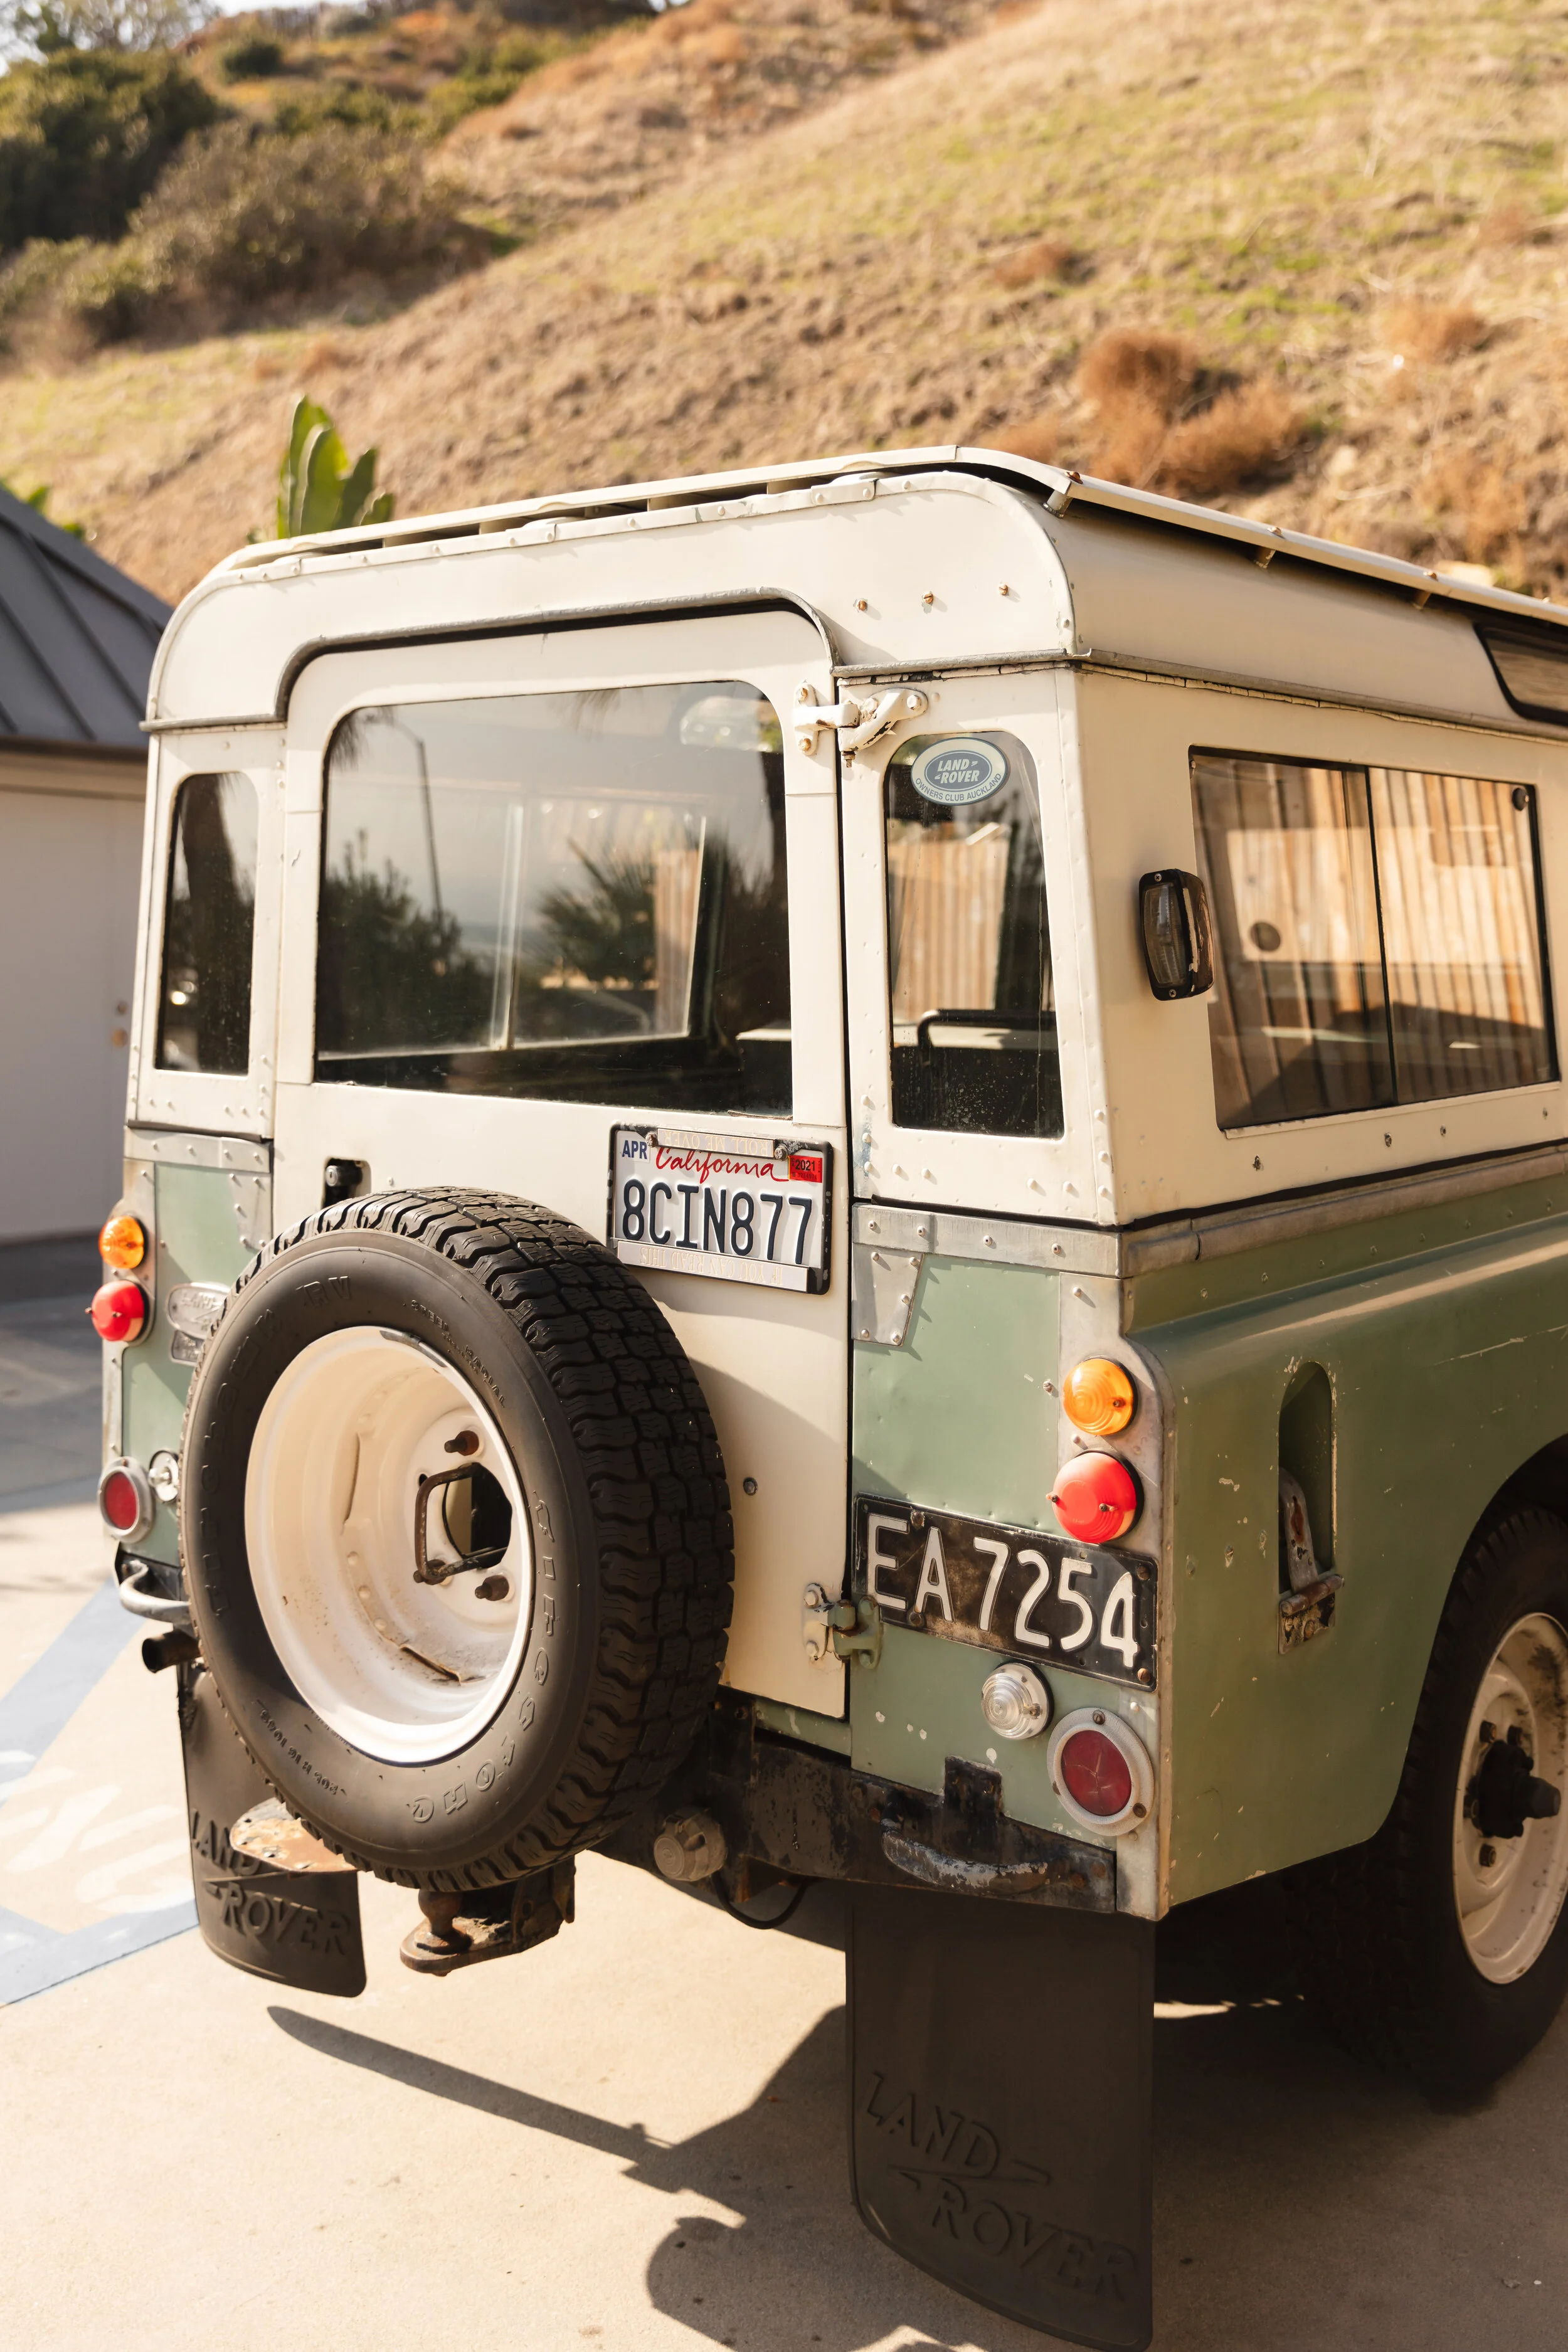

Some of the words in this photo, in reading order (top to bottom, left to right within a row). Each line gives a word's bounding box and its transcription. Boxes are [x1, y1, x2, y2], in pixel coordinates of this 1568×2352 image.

[937, 759, 970, 771] LAND
[940, 770, 980, 784] ROVER
[916, 778, 943, 800] OWNERS
[945, 793, 965, 802] CLUB
[967, 773, 1002, 800] AUCKLAND
[663, 1131, 700, 1144] OVER
[705, 1134, 725, 1148] ME
[728, 1136, 768, 1154] ROLL
[622, 1140, 647, 1160] APR
[655, 1147, 789, 1184] California
[795, 1158, 815, 1172] 2021
[622, 1179, 813, 1264] 8CIN877
[640, 1247, 666, 1267] THIS
[670, 1251, 704, 1274] READ
[709, 1258, 735, 1278] CAN
[739, 1262, 766, 1283] YOU
[770, 1264, 784, 1280] IF
[867, 1513, 955, 1623] EA
[973, 1536, 1139, 1668] 7254
[221, 1882, 351, 1956] ROVER
[866, 2072, 1000, 2180] LAND
[931, 2177, 1138, 2302] ROVER
